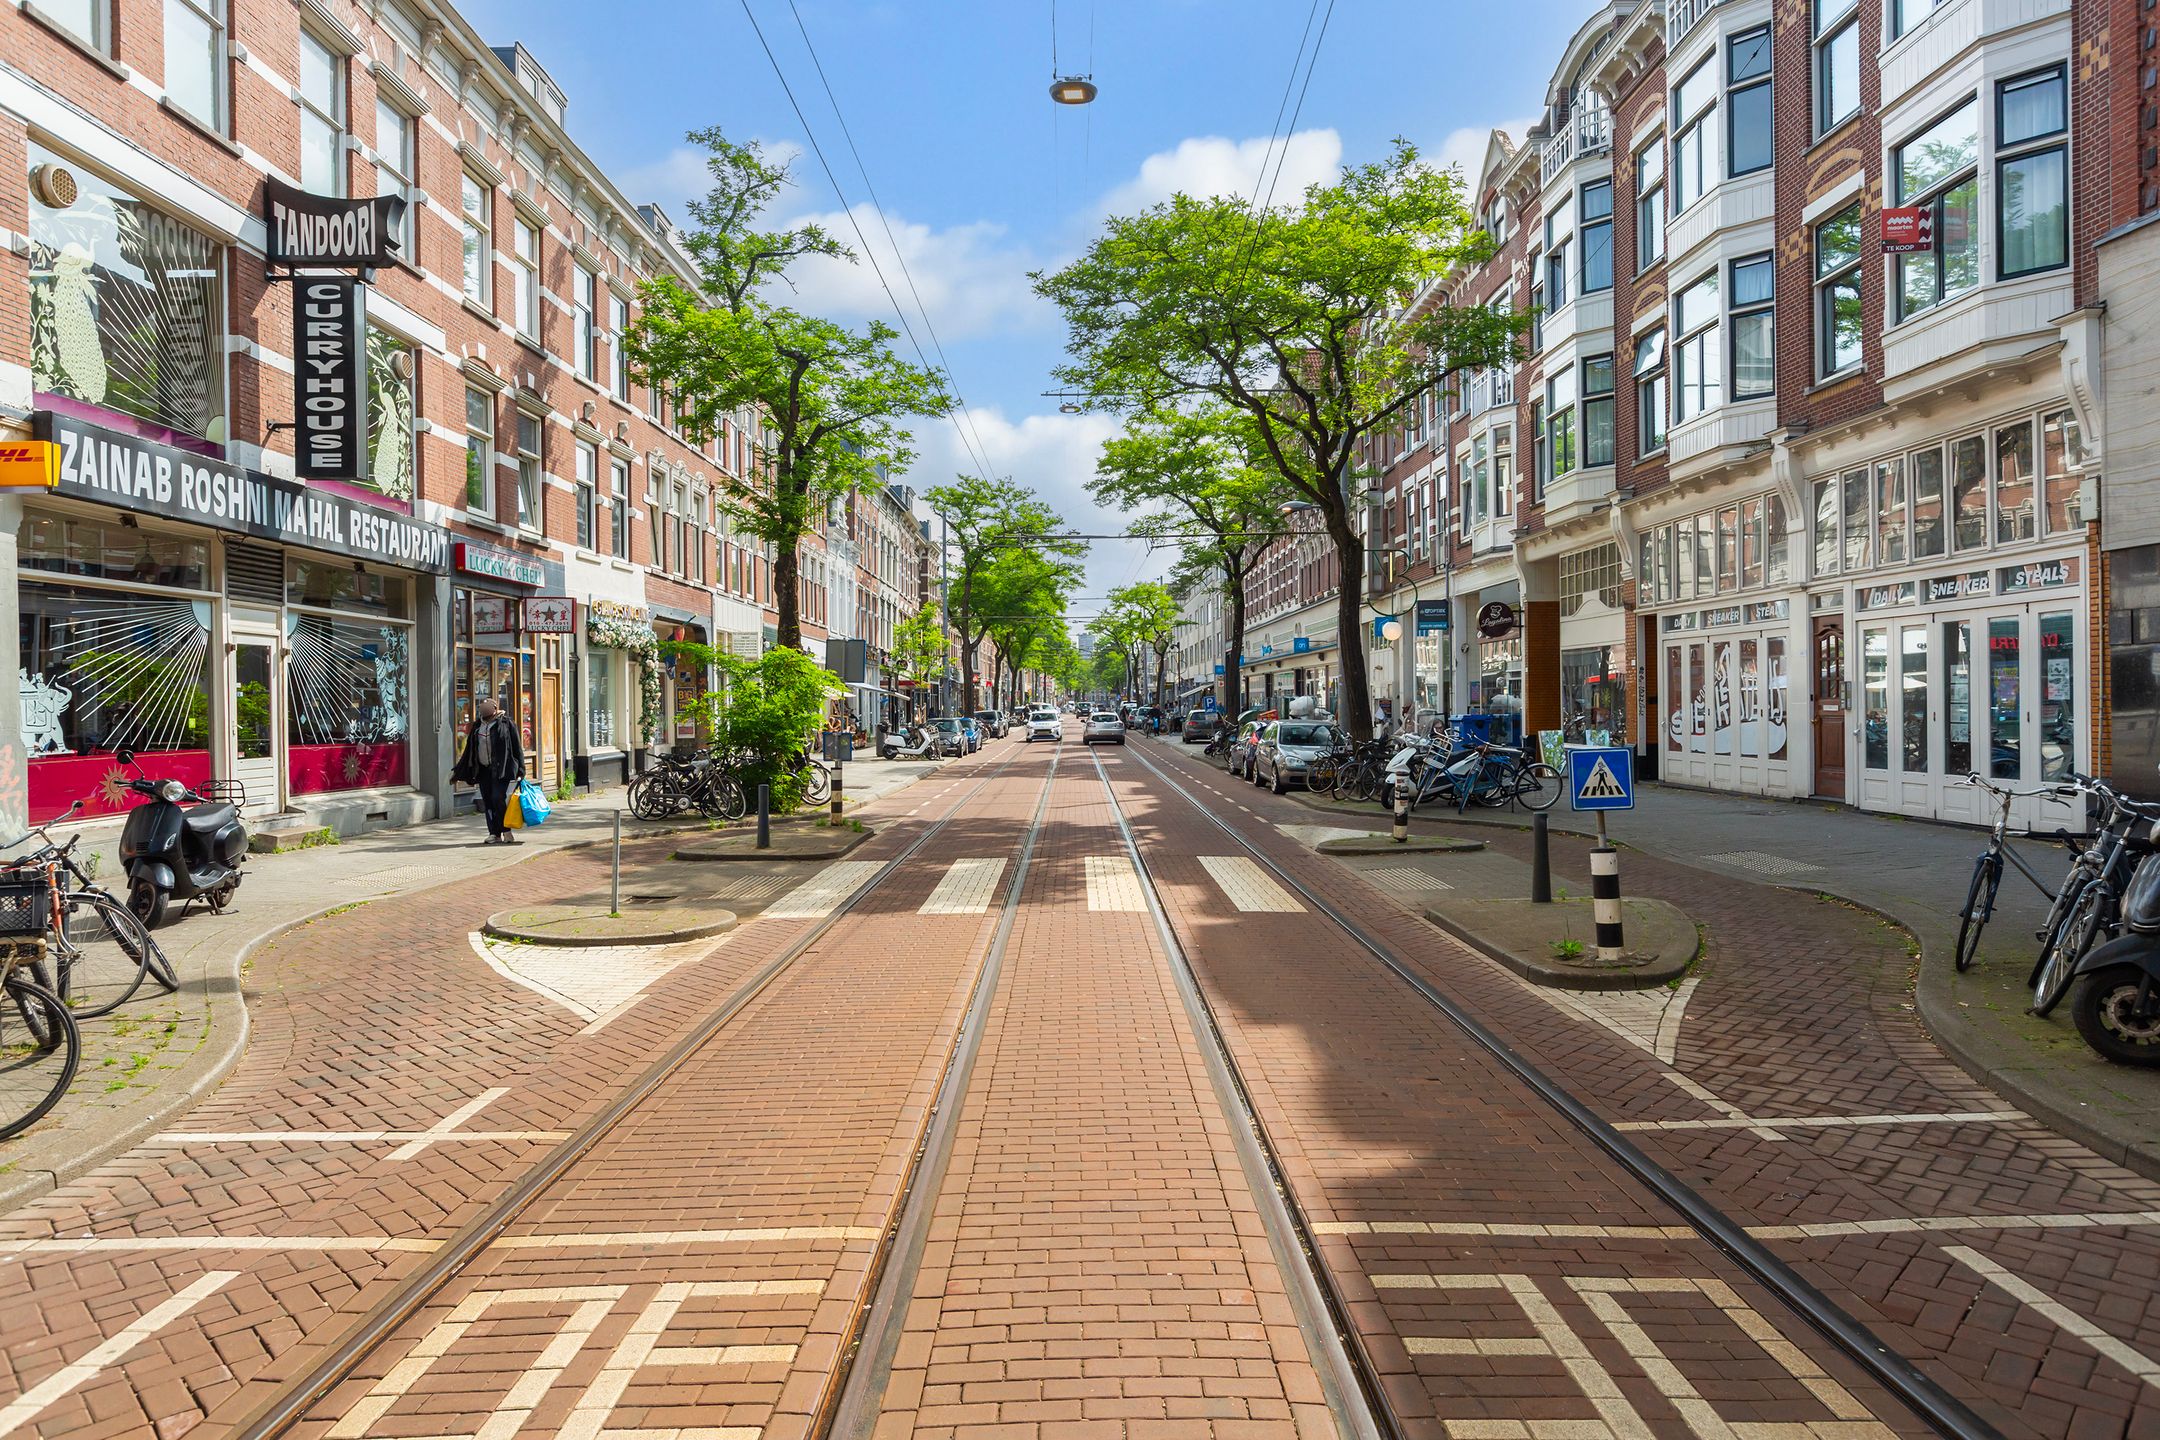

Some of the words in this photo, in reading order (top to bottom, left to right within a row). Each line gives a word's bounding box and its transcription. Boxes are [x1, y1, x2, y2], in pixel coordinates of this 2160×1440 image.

[274, 201, 376, 256] TANDOORI
[0, 449, 33, 462] HL
[60, 429, 172, 503] ZAINAB
[181, 463, 267, 526] ROSHNI
[275, 489, 343, 544] MAHAL
[350, 510, 447, 567] RESTAURANT
[469, 555, 504, 576] LUCKY
[1871, 588, 1904, 606] DAILY
[1930, 577, 1990, 598] SNEAKER
[2015, 565, 2070, 585] STEALS
[1708, 610, 1739, 624] SNEAKER
[1756, 605, 1779, 617] STEA
[1206, 698, 1213, 708] P
